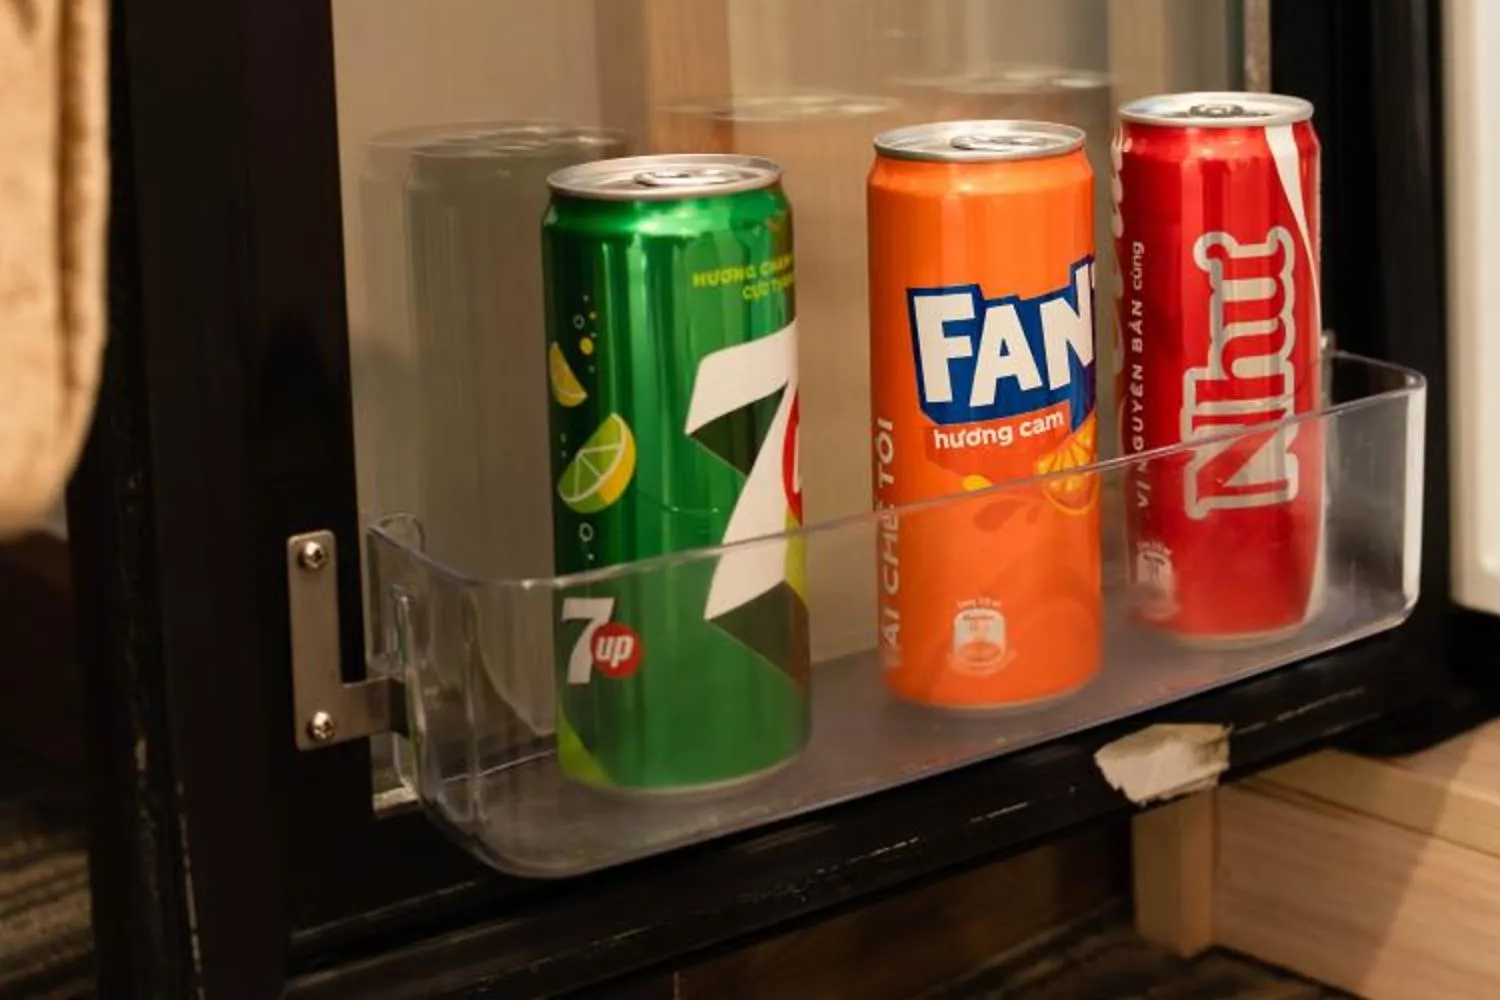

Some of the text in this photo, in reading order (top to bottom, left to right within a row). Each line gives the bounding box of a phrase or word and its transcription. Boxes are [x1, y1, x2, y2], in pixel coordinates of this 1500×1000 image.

[913, 263, 1096, 408] FAN
[934, 411, 1064, 450] hương cam
